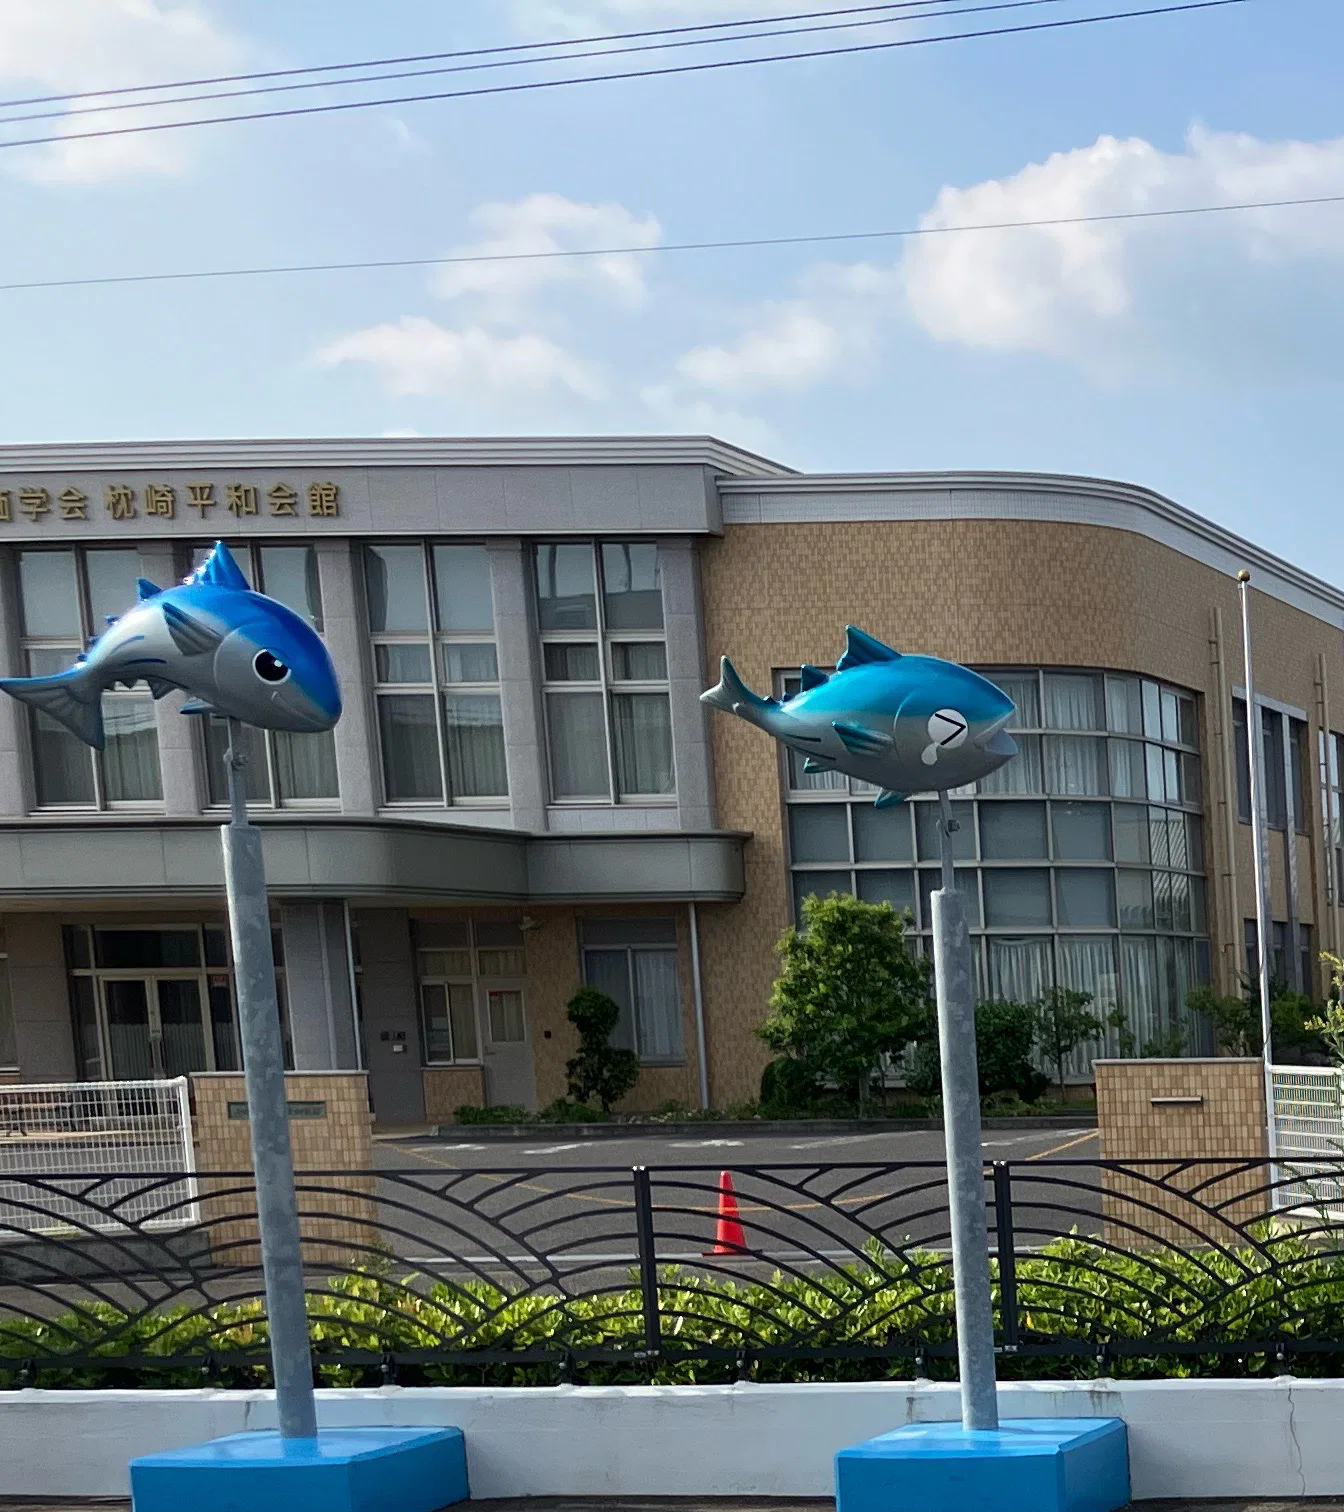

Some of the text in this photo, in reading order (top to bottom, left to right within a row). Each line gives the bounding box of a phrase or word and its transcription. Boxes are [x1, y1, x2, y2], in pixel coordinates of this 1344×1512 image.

[103, 482, 339, 519] 枕崎平和会館
